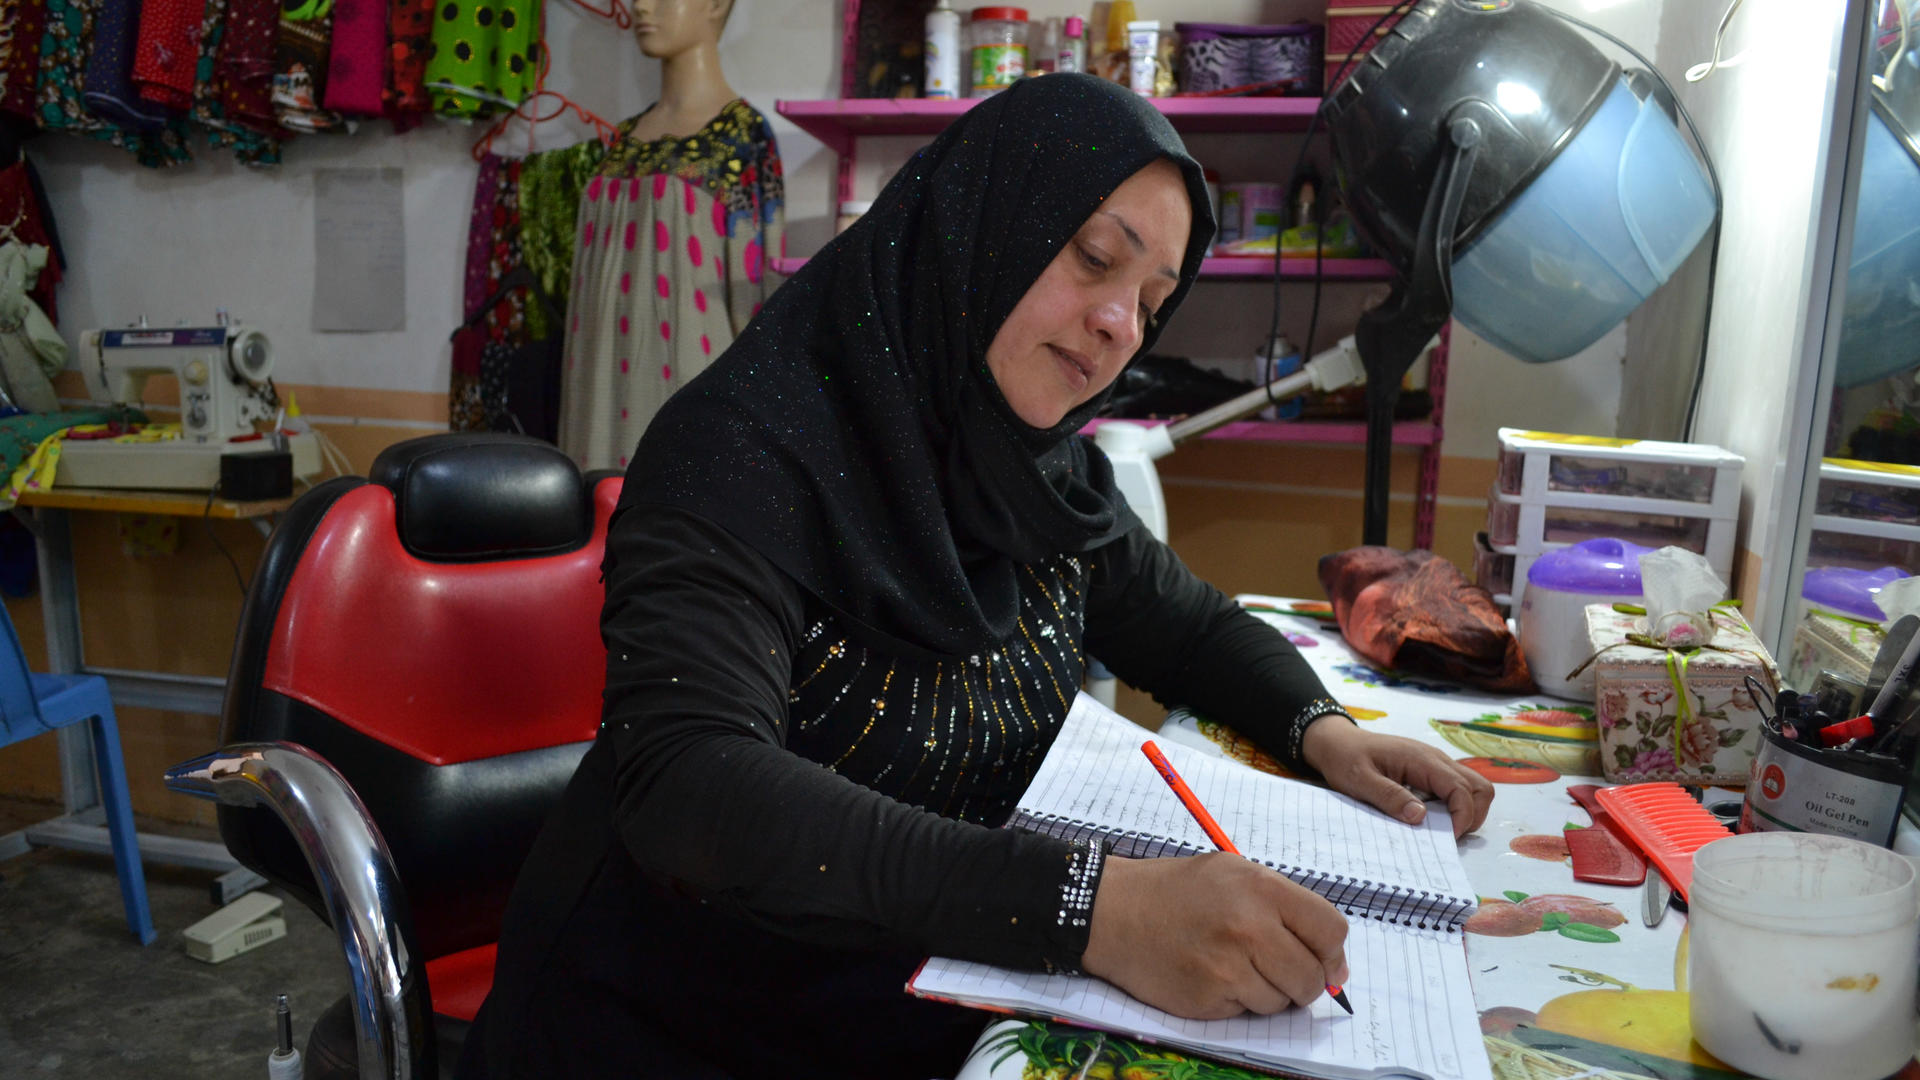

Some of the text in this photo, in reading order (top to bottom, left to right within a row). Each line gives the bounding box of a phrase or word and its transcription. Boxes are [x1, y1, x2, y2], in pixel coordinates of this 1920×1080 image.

[1805, 800, 1869, 827] Oil Gel Pen
